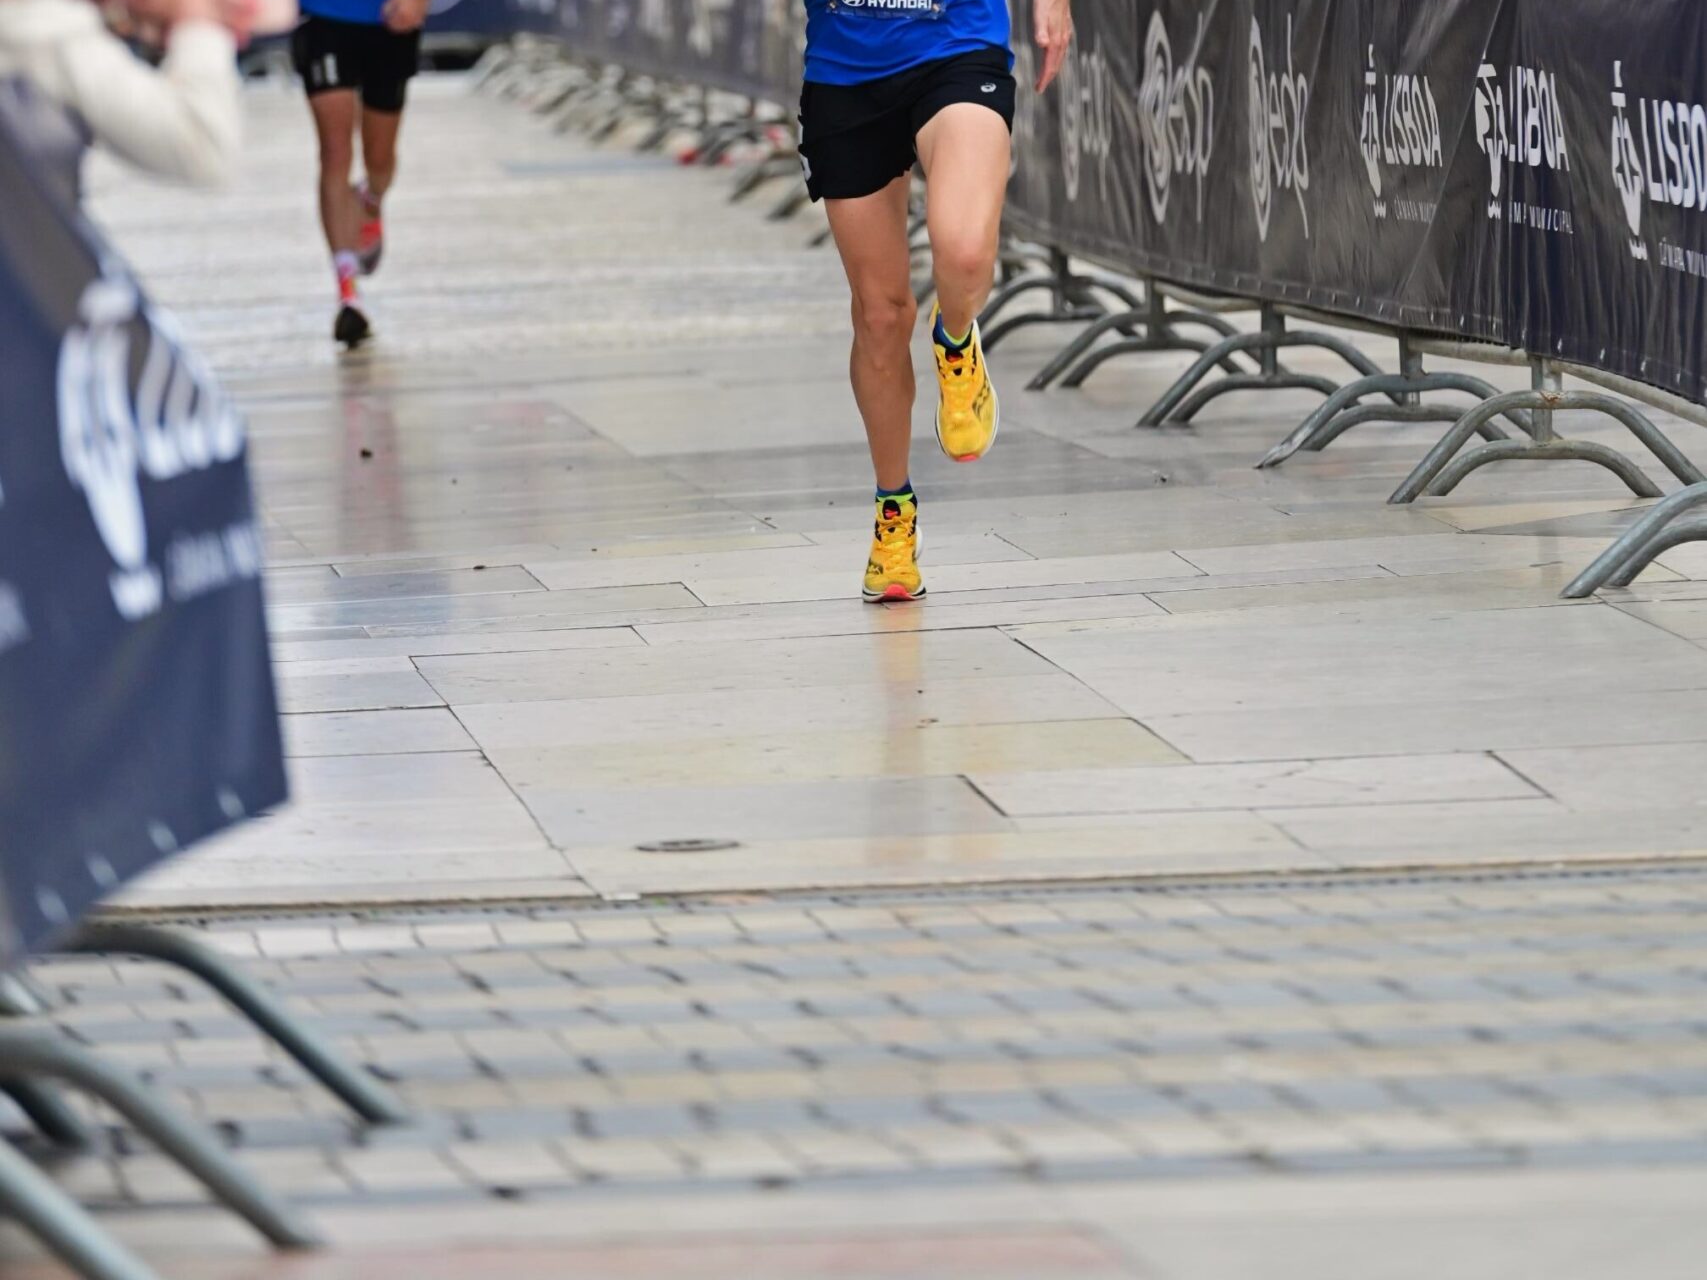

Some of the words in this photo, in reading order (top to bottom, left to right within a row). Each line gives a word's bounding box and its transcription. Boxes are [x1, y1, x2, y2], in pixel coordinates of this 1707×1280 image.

[1168, 11, 1214, 223] edp
[1268, 12, 1310, 240] edp
[1382, 74, 1443, 168] LISBOA
